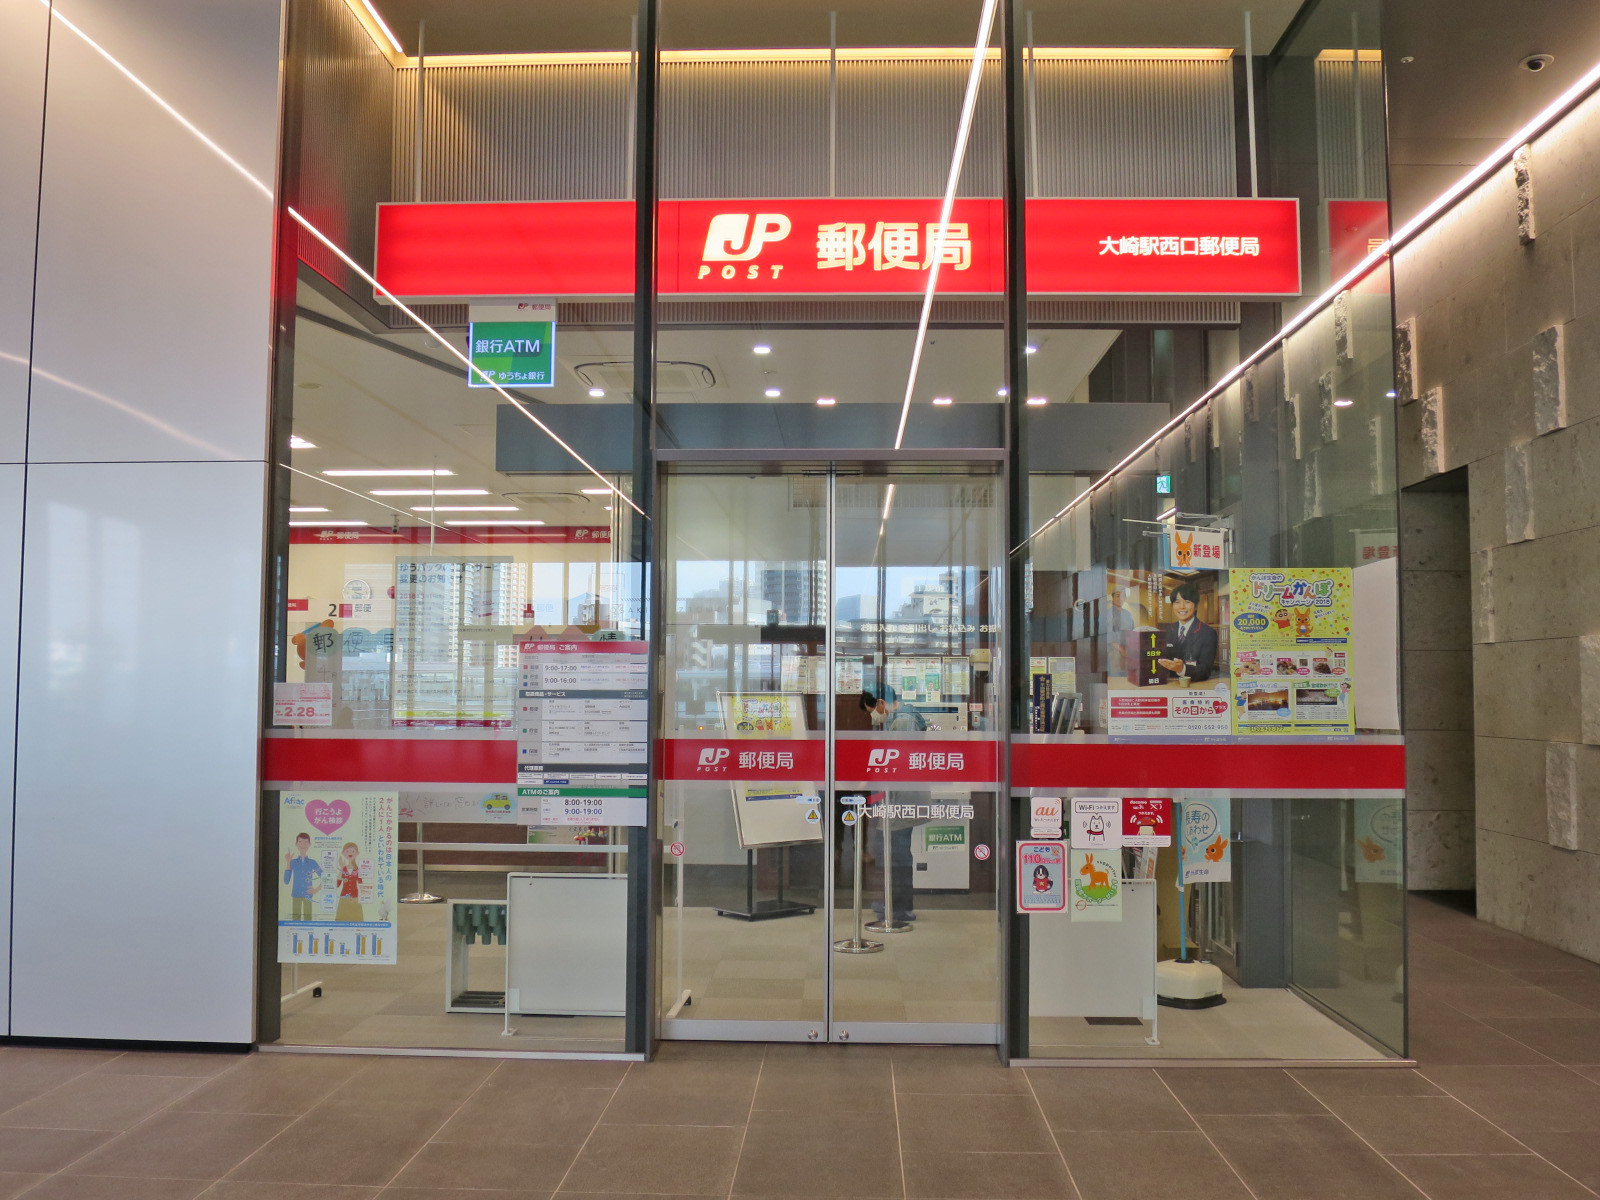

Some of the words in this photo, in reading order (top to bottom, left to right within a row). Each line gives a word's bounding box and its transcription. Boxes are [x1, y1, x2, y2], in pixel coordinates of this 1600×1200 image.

[816, 221, 971, 271] 郵便局
[1098, 236, 1260, 257] 大崎駅西口郵便局
[697, 265, 783, 279] POST
[475, 340, 541, 354] 銀行ATM
[498, 371, 545, 381] ゆうちょ銀行
[1193, 544, 1221, 559] 新登場
[1253, 580, 1333, 600] ドリームかんぽ
[328, 603, 337, 617] 2
[355, 603, 372, 613] 郵便
[940, 624, 976, 633] お払込み
[1238, 618, 1267, 626] 20,000
[544, 664, 578, 672] 9:00-17:00
[738, 751, 795, 770] 郵便局
[908, 752, 965, 771] 郵便局
[521, 788, 560, 796] ATMのご案内
[315, 807, 343, 816] 行こうよ
[857, 803, 975, 820] 大崎駅西口郵便局
[1035, 806, 1059, 816] au
[314, 816, 343, 825] がん検診
[385, 796, 394, 882] がんにかかるのは日本人の
[928, 833, 963, 842] 銀行ATM
